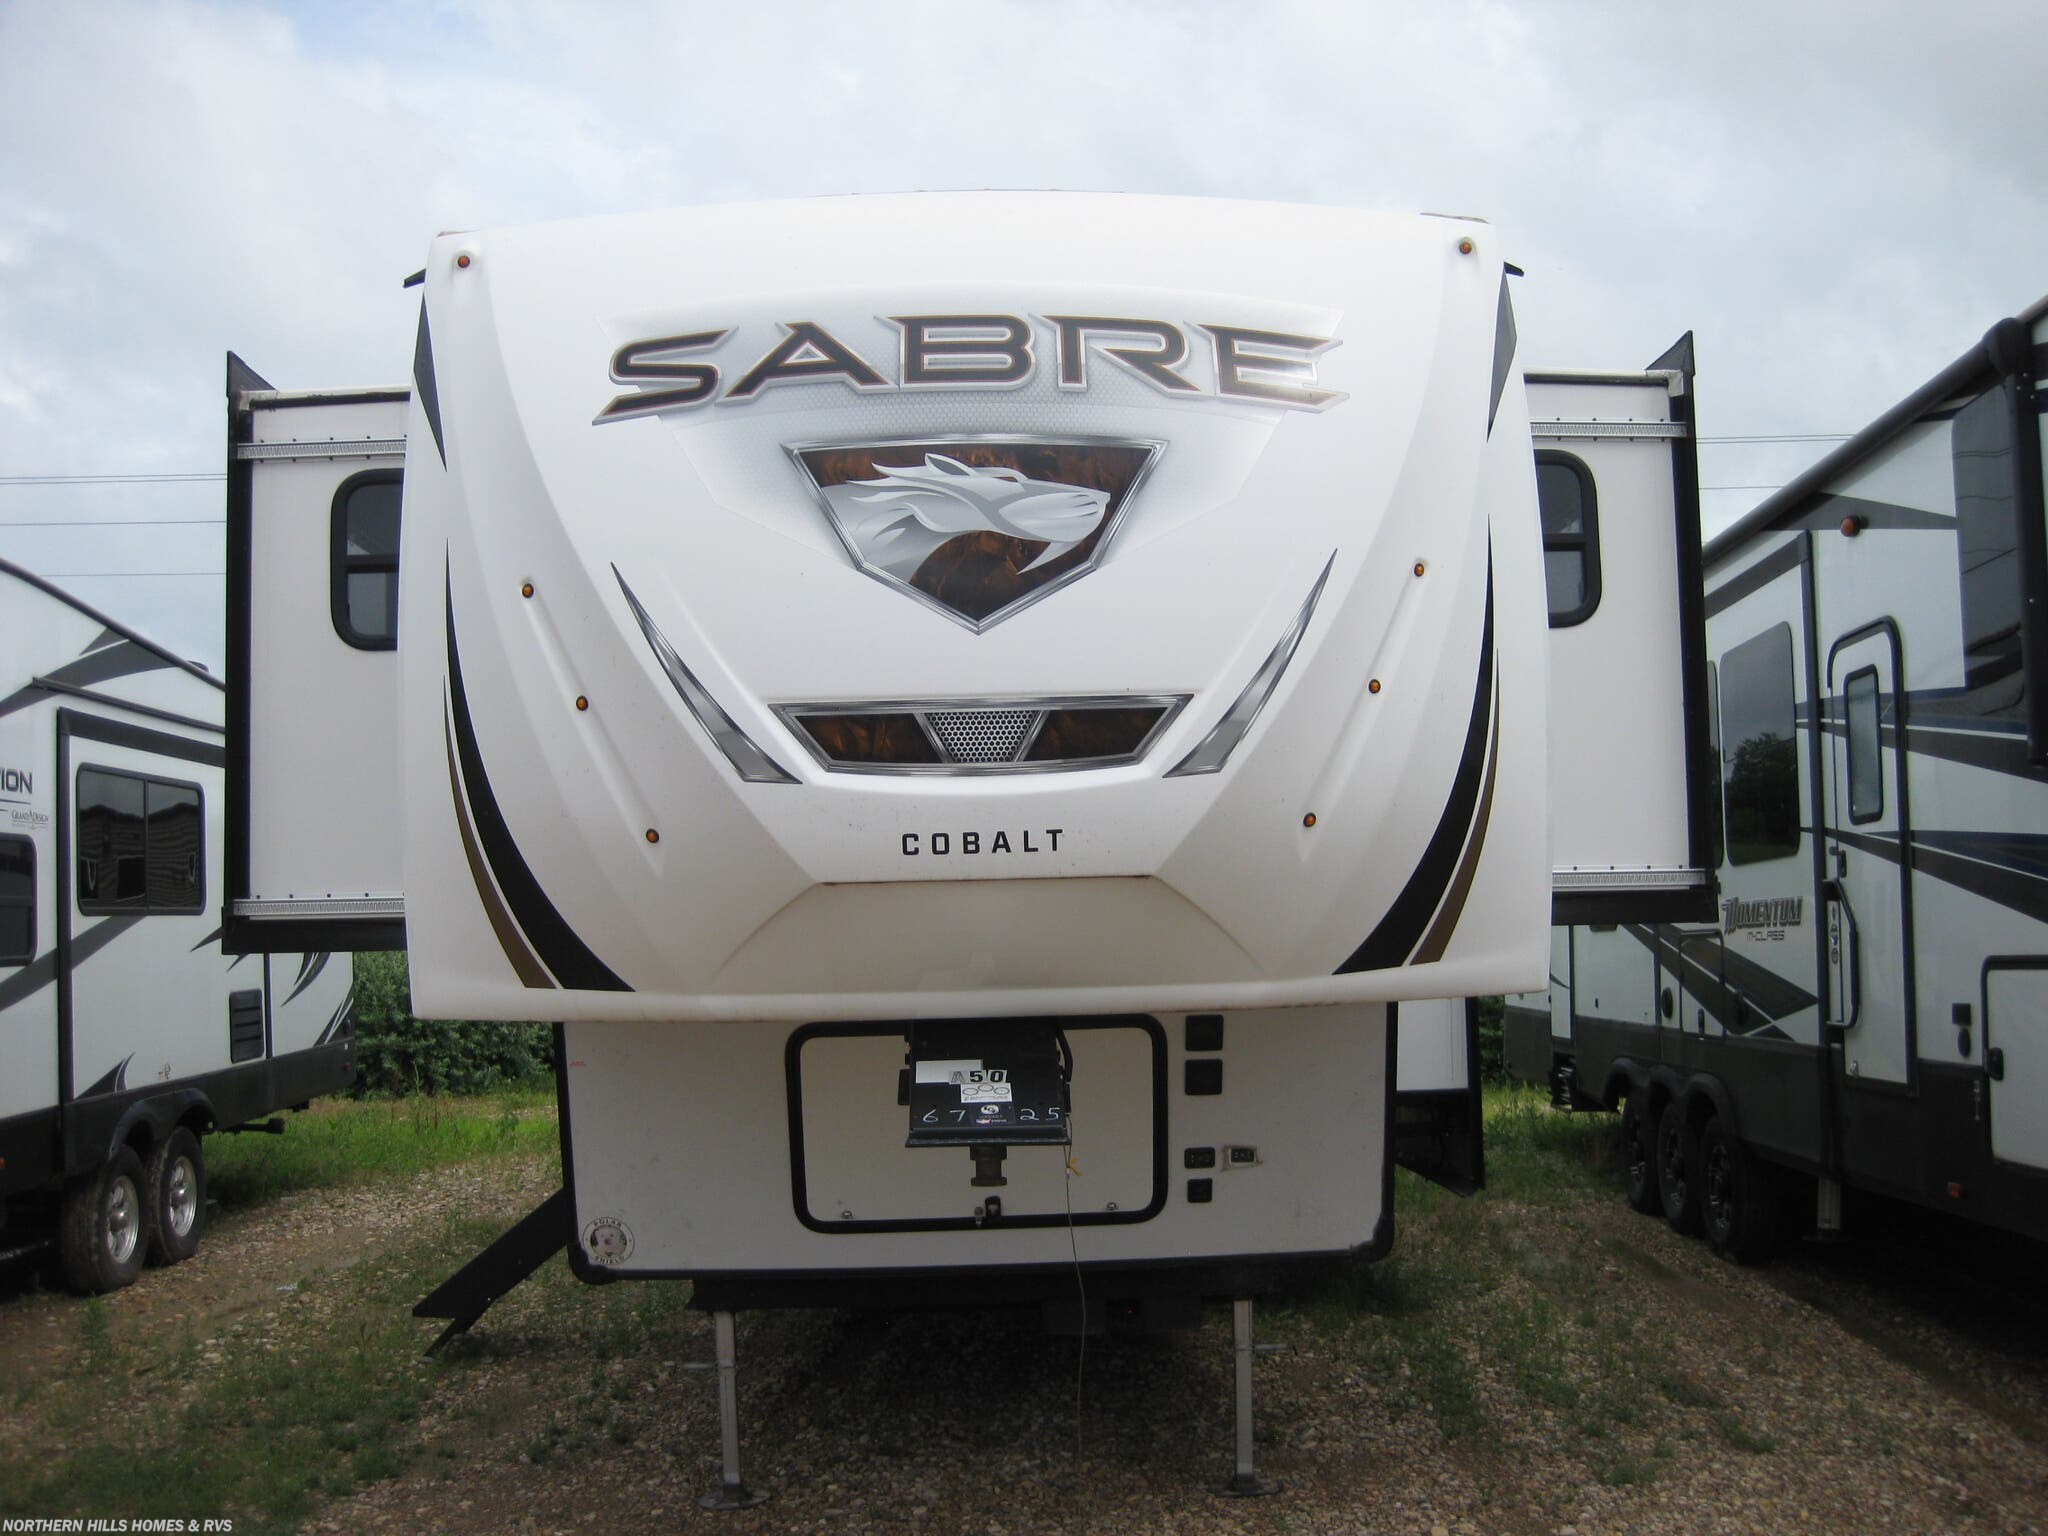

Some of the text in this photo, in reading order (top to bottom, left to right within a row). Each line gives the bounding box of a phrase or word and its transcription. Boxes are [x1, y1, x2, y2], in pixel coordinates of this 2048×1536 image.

[593, 314, 1348, 425] SABRE
[0, 769, 33, 794] ION
[902, 829, 1063, 855] COBALT
[1720, 896, 1803, 935] MOMENTUM
